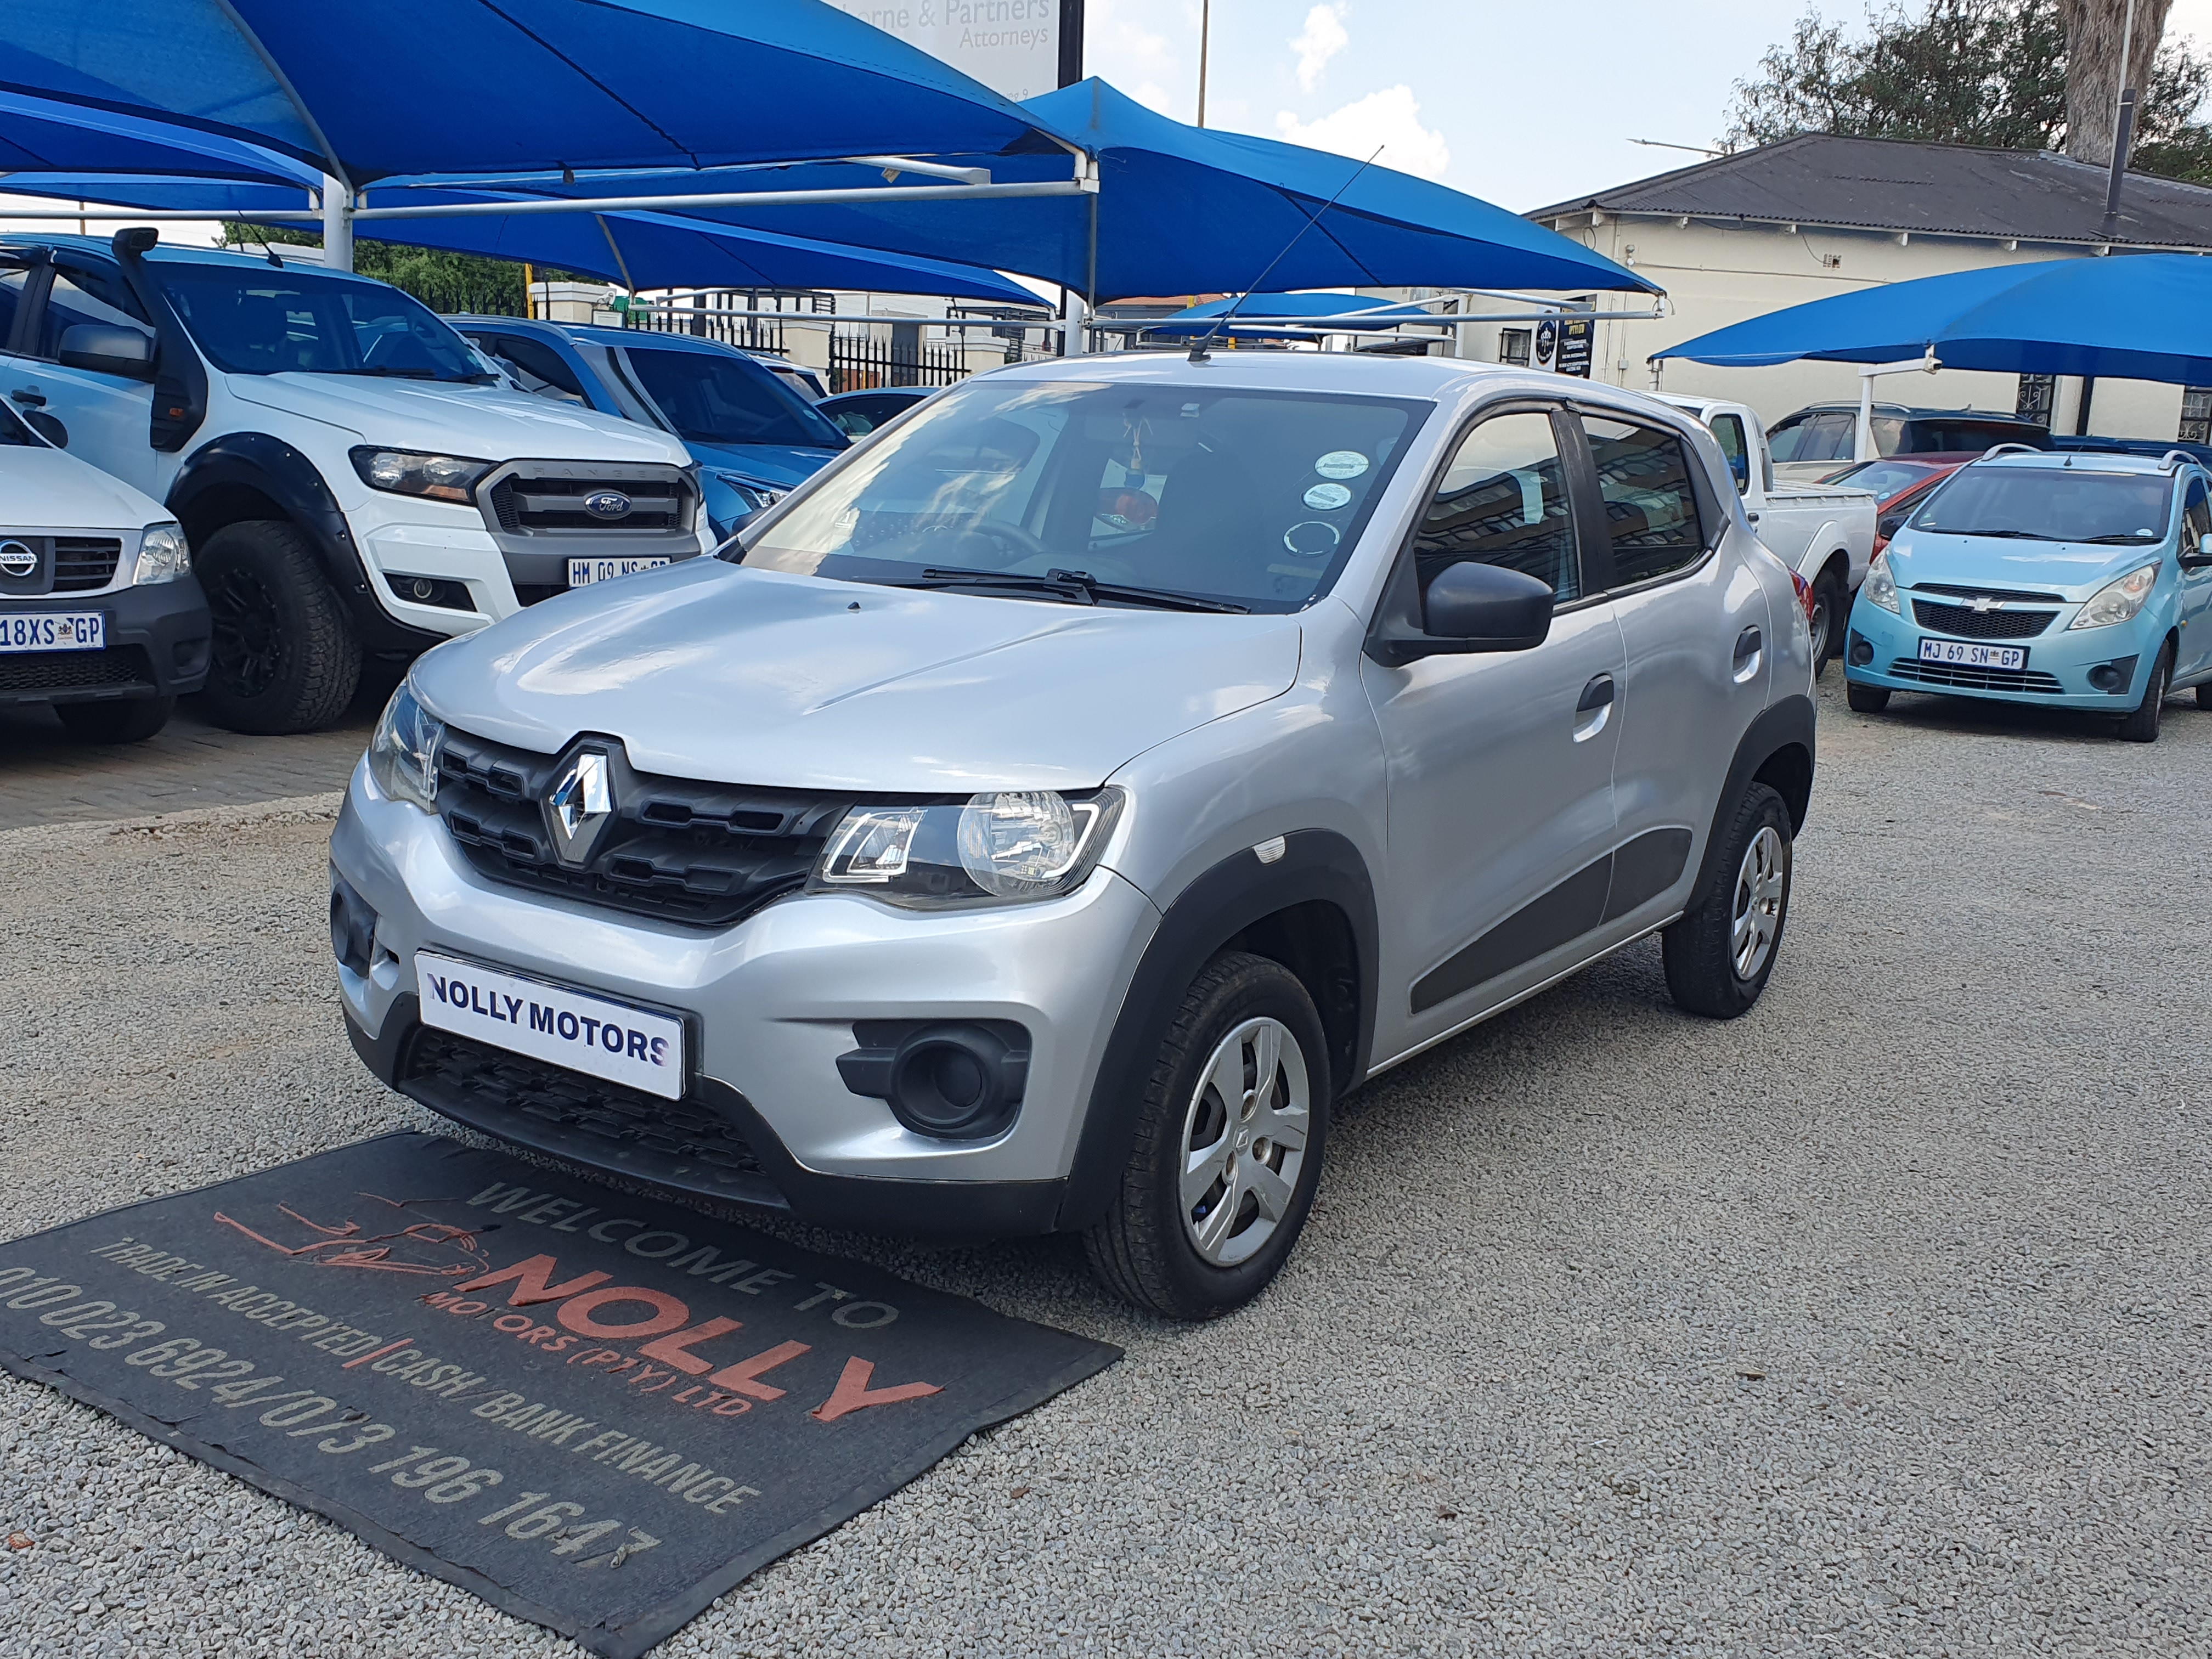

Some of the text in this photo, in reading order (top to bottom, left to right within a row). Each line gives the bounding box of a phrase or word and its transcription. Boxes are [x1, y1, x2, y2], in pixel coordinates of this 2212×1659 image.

[918, 0, 935, 27] &
[945, 0, 1049, 25] Partners
[960, 27, 1048, 50] Attorneys
[599, 497, 624, 511] Ford
[572, 561, 590, 584] HM
[76, 617, 99, 644] GP
[1923, 642, 2019, 667] MJ 69 SN GP
[427, 972, 669, 1067] NOLLY MOTORS
[466, 1181, 900, 1329] WELCOME TO
[414, 1291, 752, 1416] MOTORS (PTY) LTD
[454, 1254, 947, 1422] NOLLY
[90, 1237, 205, 1282] TRADE
[171, 1270, 239, 1293] IN
[572, 1429, 762, 1514] FINANCE
[40, 1301, 166, 1350] 023
[368, 1445, 505, 1505] 196
[477, 1491, 663, 1569] 1647
